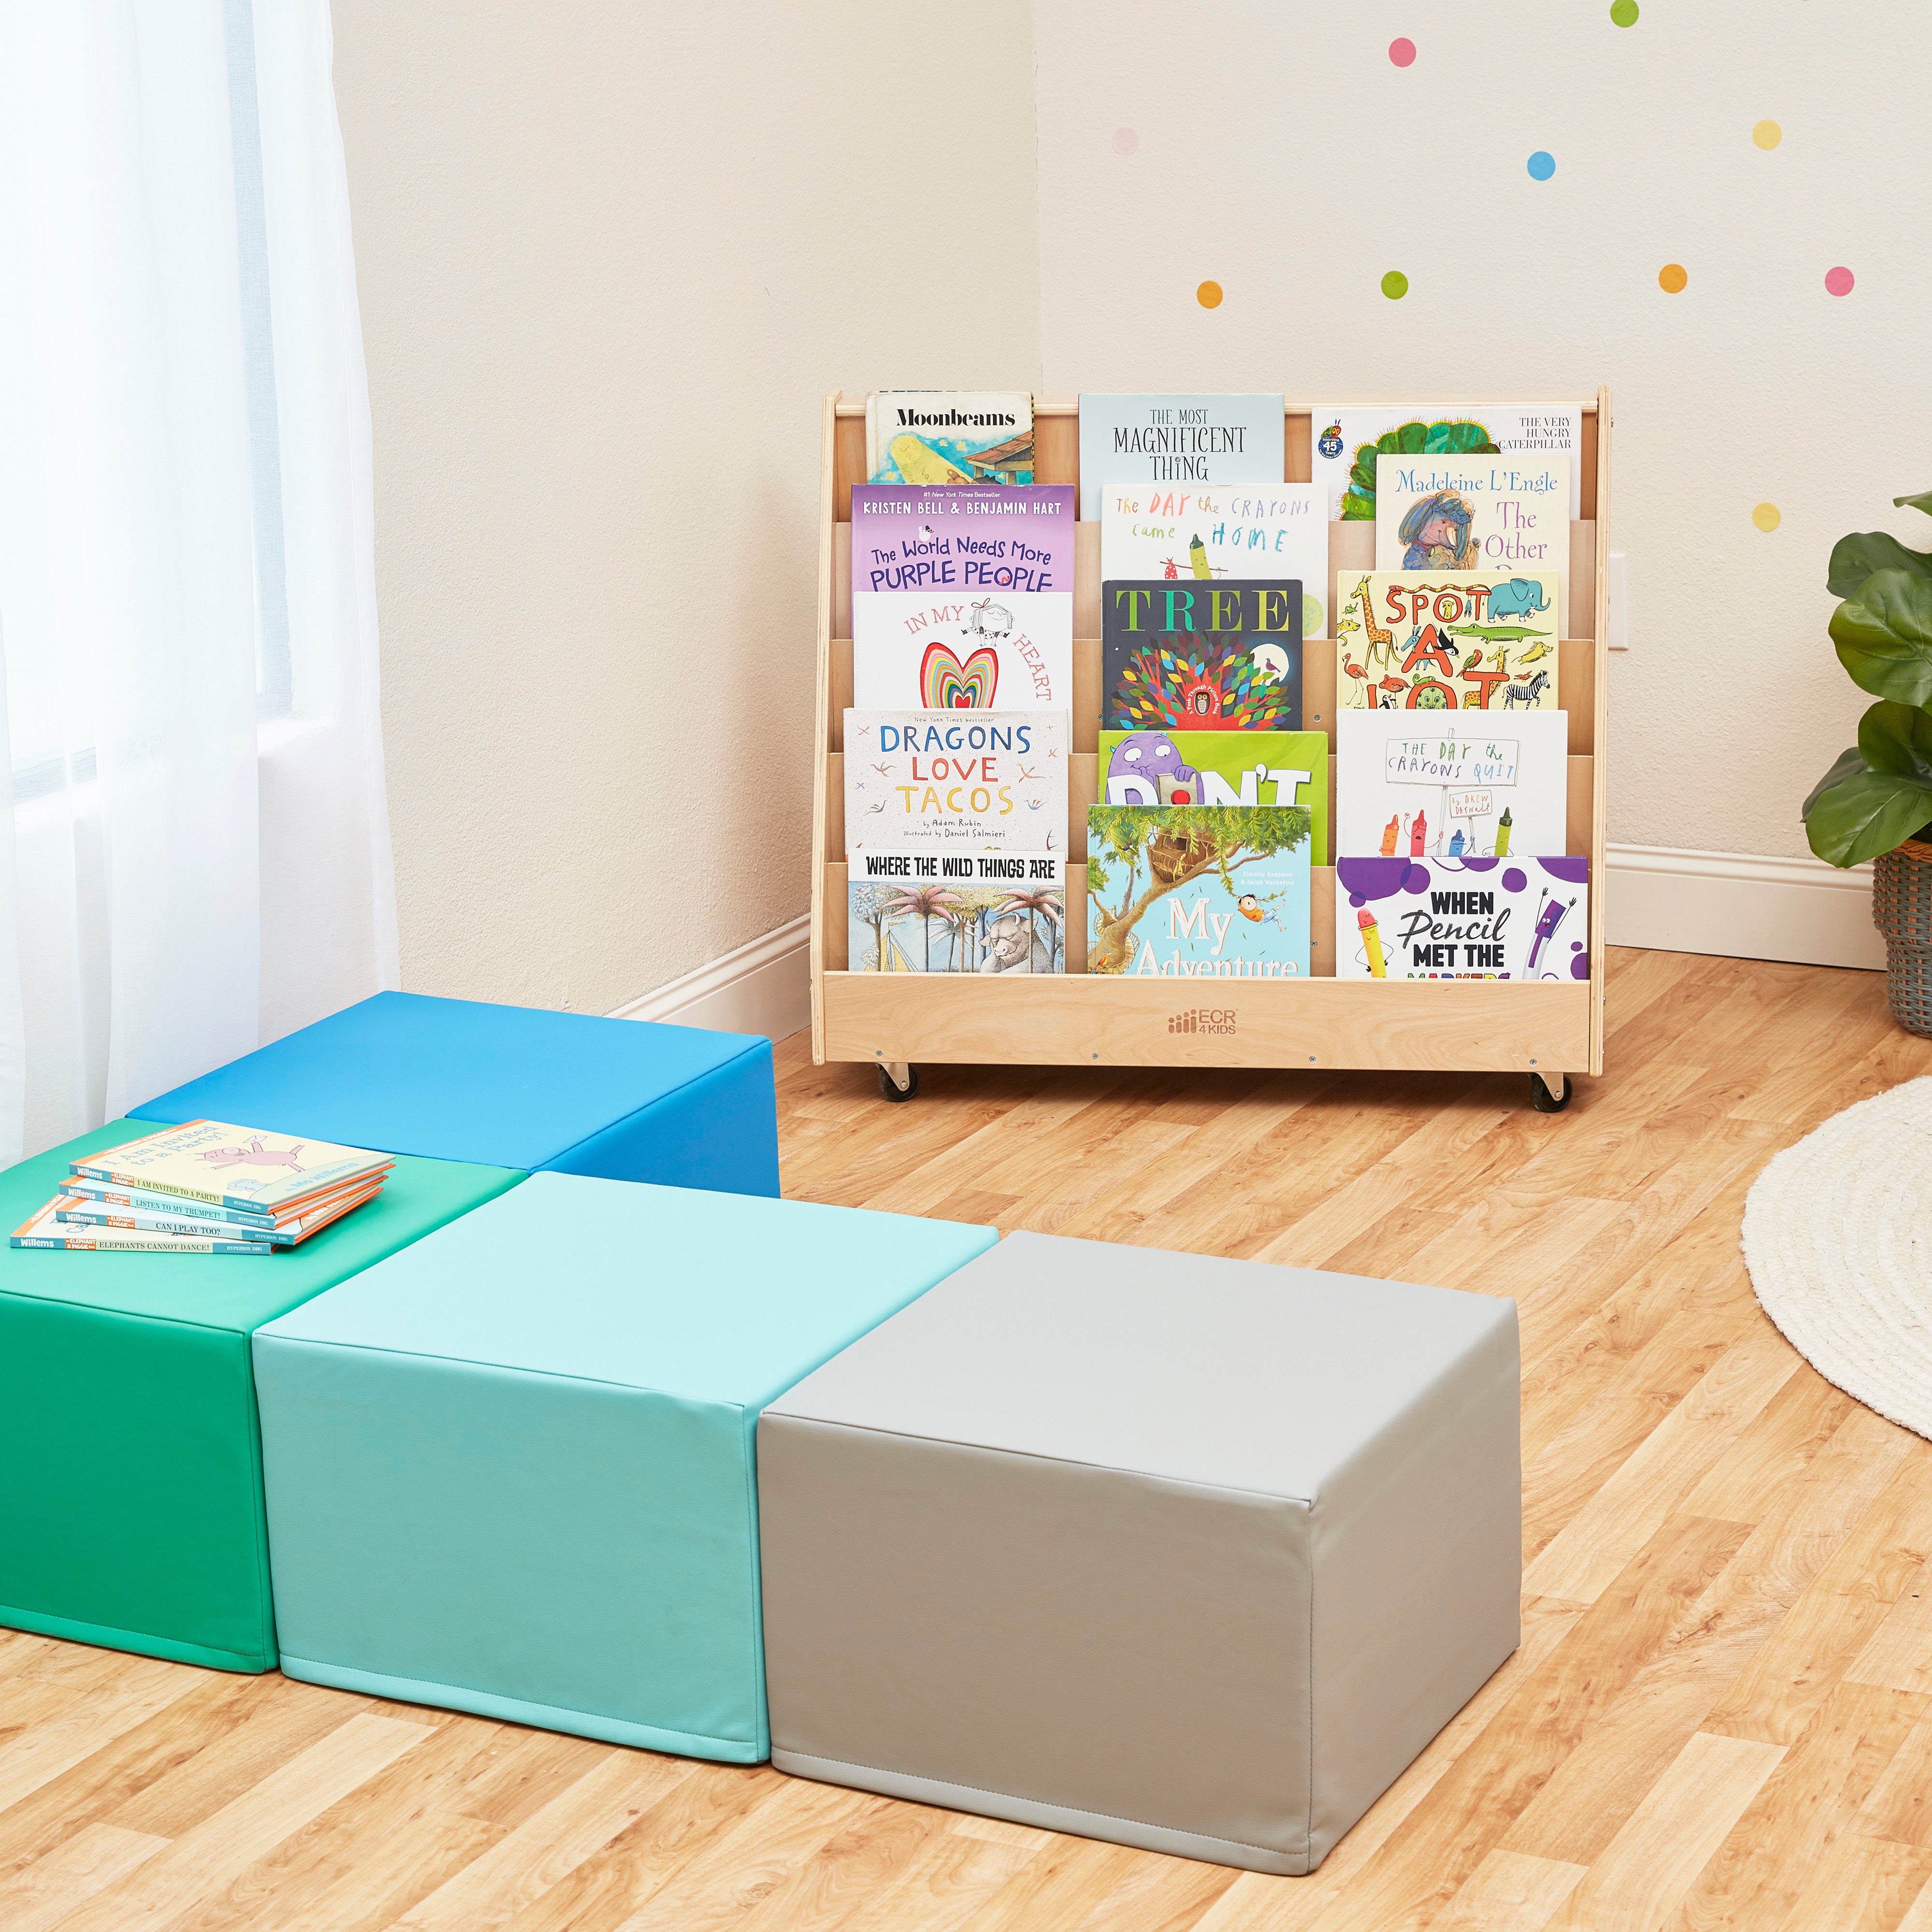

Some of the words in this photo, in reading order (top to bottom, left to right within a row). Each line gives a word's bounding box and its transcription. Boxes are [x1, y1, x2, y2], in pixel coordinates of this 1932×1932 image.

[896, 409, 1015, 426] Moonbeams
[1150, 409, 1172, 424] THE
[1179, 409, 1208, 425] MOST
[1519, 417, 1542, 426] THE
[1544, 417, 1572, 426] VERY
[1113, 427, 1246, 453] MAGNIFICENT
[1499, 440, 1571, 449] CATERPILLAR
[1526, 428, 1571, 438] HUNGRY
[1323, 441, 1336, 451] 45
[1395, 469, 1483, 493] Madeleine
[864, 502, 911, 514] KRISTEN
[918, 502, 944, 514] BELL
[951, 502, 960, 514] &
[967, 502, 1027, 515] BENJAMIN
[1034, 502, 1061, 515] HART
[1117, 497, 1139, 514] The
[1150, 492, 1191, 516] DAY
[1197, 496, 1219, 514] the
[1232, 497, 1310, 519] CRAYONS
[1497, 501, 1536, 529] The
[1212, 523, 1289, 552] HOME
[1485, 533, 1548, 560] Other
[871, 549, 896, 565] The
[902, 537, 950, 557] World
[957, 537, 1005, 558] Needs
[1011, 541, 1051, 565] More
[870, 560, 956, 591] PURPLE
[966, 561, 1052, 591] PEOPLE
[1116, 590, 1290, 632] TREE
[1386, 590, 1492, 625] SPOT
[904, 612, 928, 635] IN
[931, 606, 965, 624] MY
[1401, 624, 1453, 677] A
[1012, 633, 1052, 701] HEART
[1187, 684, 1207, 710] Peek-Through
[1207, 686, 1218, 701] Picture
[881, 725, 1031, 754] DRAGONS
[1402, 743, 1426, 755] THE
[1439, 742, 1471, 761] DAY
[1486, 743, 1503, 760] the
[912, 757, 998, 781] LOVE
[1389, 756, 1462, 778] CRAYONS
[1474, 763, 1514, 783] QUIT
[895, 786, 1013, 815] TACOS
[1465, 795, 1488, 803] DREW
[945, 829, 968, 838] Daniel
[972, 829, 1005, 838] Salmieri
[866, 856, 910, 876] WHERE
[914, 857, 937, 876] THE
[942, 858, 973, 877] WILD
[978, 858, 1024, 878] THINGS
[1029, 860, 1055, 879] ARE
[1431, 892, 1493, 914] WHEN
[1165, 898, 1235, 956] My
[1397, 908, 1510, 949] Pencil
[1136, 939, 1298, 977] Adventure
[1414, 944, 1458, 967] MET
[1464, 944, 1505, 967] THE
[1199, 1009, 1236, 1024] ECR
[1198, 1025, 1207, 1034] 4
[1208, 1025, 1236, 1035] KIDS
[119, 1148, 156, 1160] Am
[149, 1126, 220, 1148] Invited
[165, 1132, 228, 1152] Party!
[77, 1167, 102, 1179] Willems
[309, 1163, 360, 1180] Willems
[68, 1188, 96, 1199] Willems
[153, 1183, 178, 1193] INVITED
[196, 1192, 219, 1202] PARTY!
[66, 1213, 97, 1223] Willems
[136, 1200, 160, 1209] LISTEN
[185, 1208, 220, 1219] TRUMPET!
[179, 1224, 198, 1233] PLAY
[200, 1227, 220, 1236] TOO?
[20, 1238, 54, 1247] Willems
[182, 1243, 209, 1251] DANCE!
